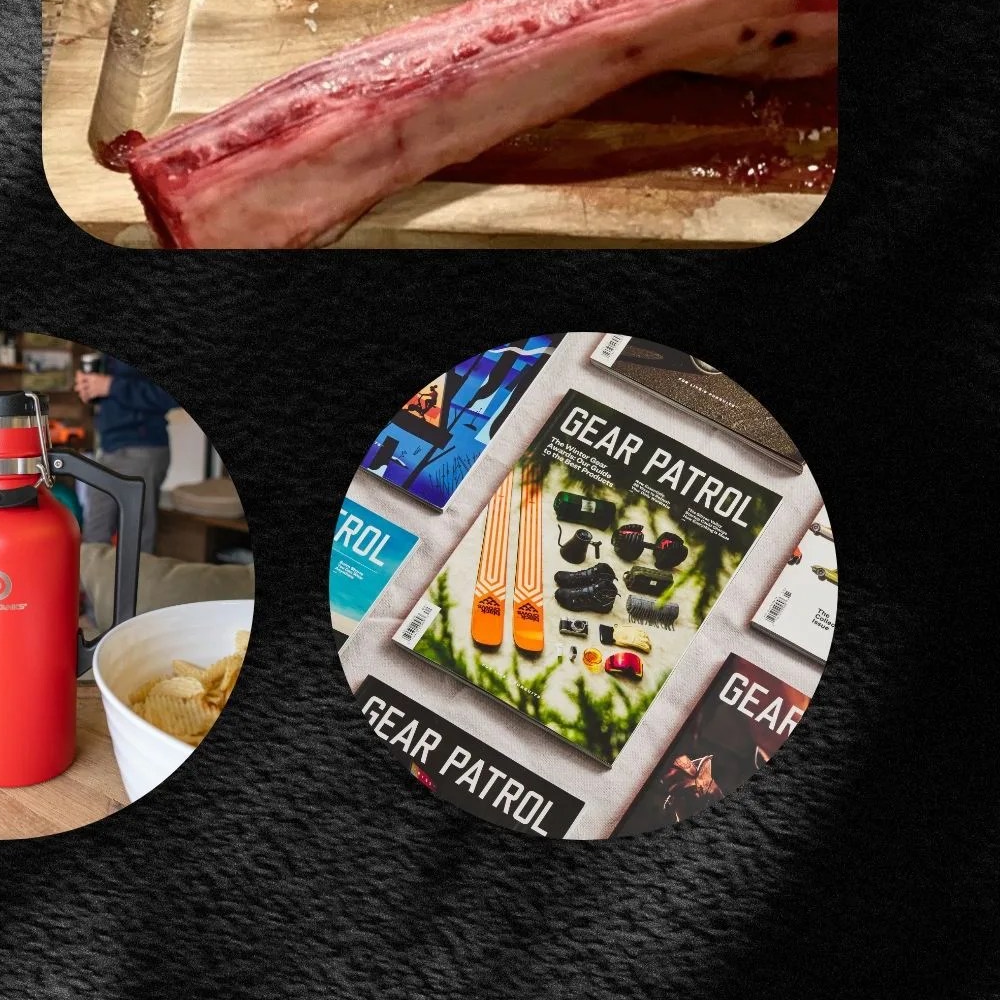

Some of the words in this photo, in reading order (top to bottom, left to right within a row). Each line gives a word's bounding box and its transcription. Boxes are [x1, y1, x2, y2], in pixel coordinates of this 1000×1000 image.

[547, 443, 576, 460] Awards:
[576, 457, 591, 468] Our
[590, 464, 612, 479] Guide
[551, 436, 565, 447] The
[565, 443, 590, 460] Winter
[590, 457, 608, 469] Gear
[552, 452, 565, 461] the
[564, 458, 581, 470] Best
[581, 467, 614, 488] Products
[560, 406, 644, 466] GEAR
[642, 447, 752, 528] PATROL
[811, 618, 829, 631] Issue
[817, 608, 830, 619] The
[719, 672, 804, 737] GEAR
[361, 695, 443, 765] GEAR
[439, 745, 554, 837] PATROL
